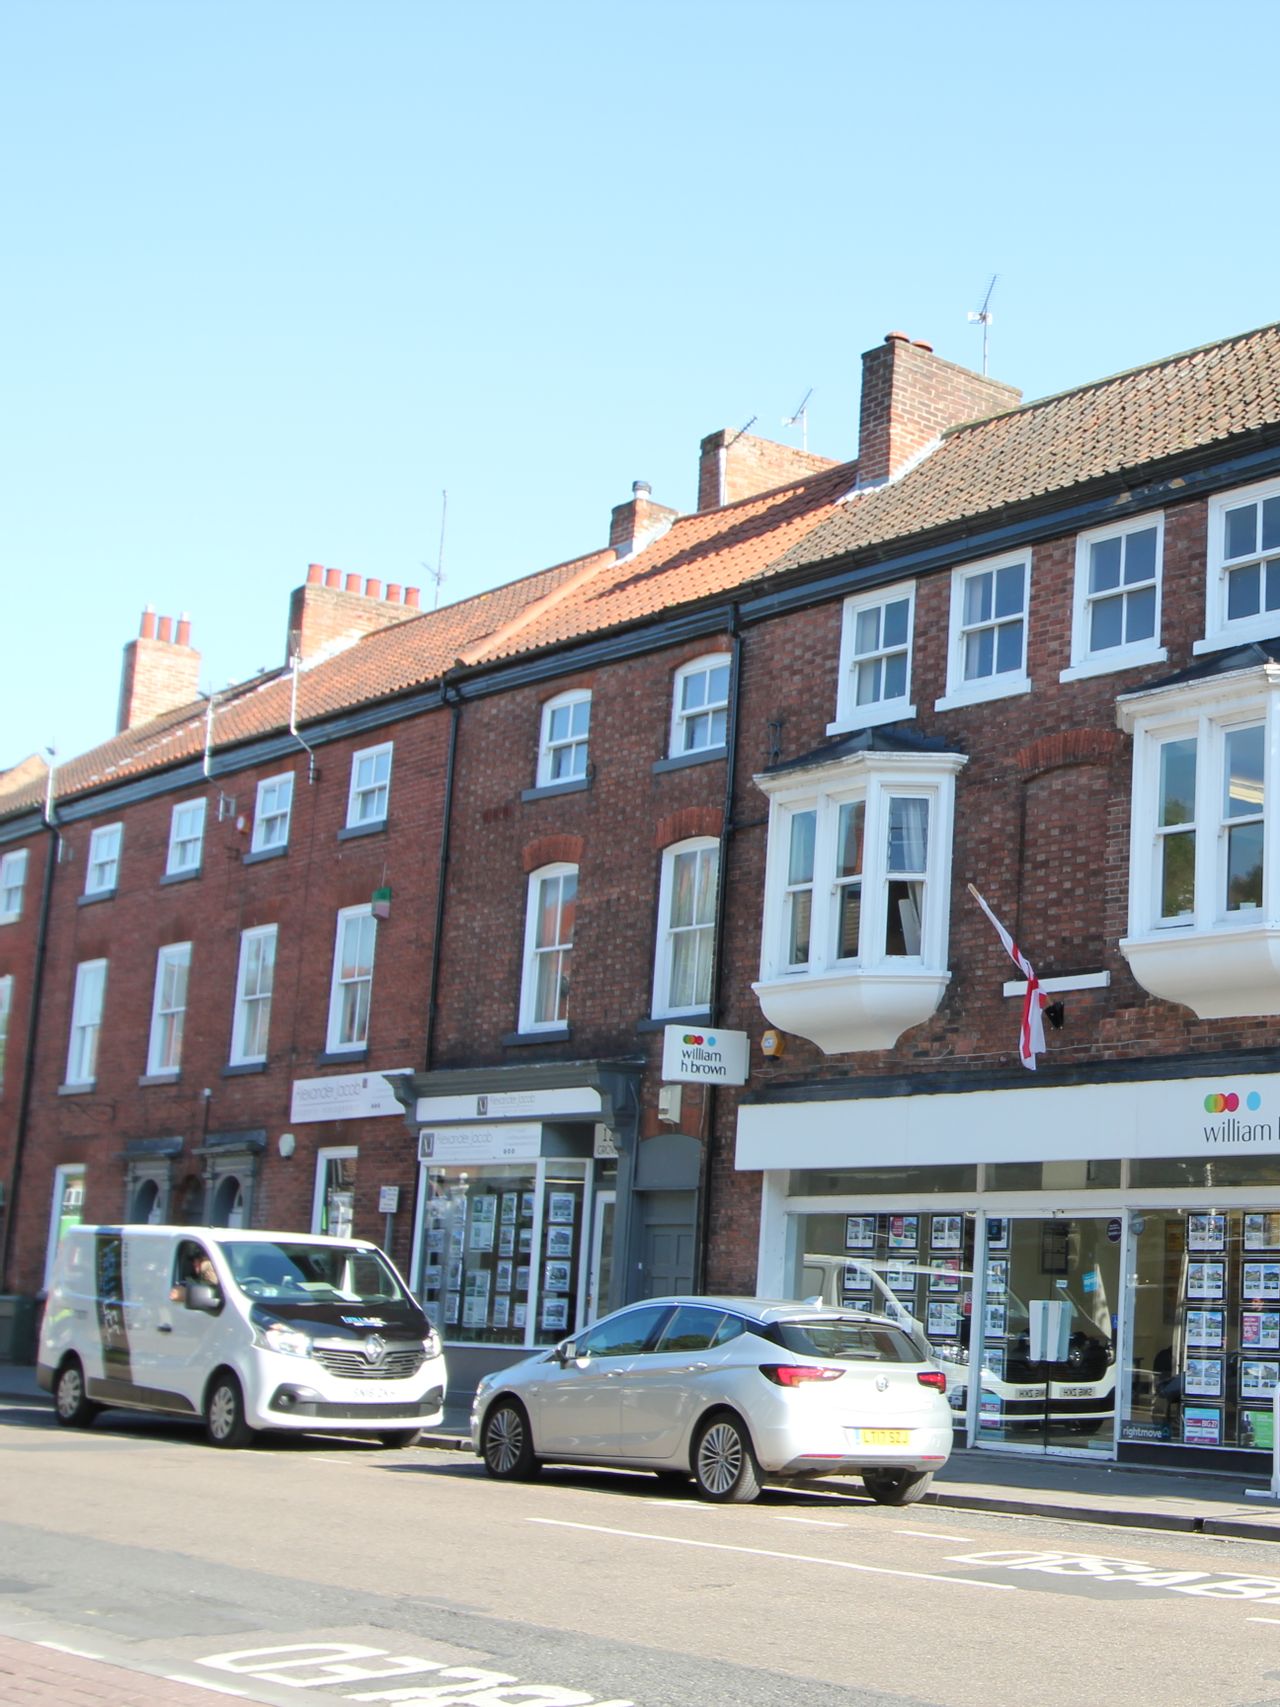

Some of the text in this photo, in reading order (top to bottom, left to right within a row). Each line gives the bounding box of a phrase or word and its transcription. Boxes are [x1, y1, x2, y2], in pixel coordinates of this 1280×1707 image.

[681, 1047, 722, 1063] william
[680, 1060, 727, 1076] h brown
[1203, 1117, 1272, 1143] william
[1122, 1425, 1163, 1440] rightmove
